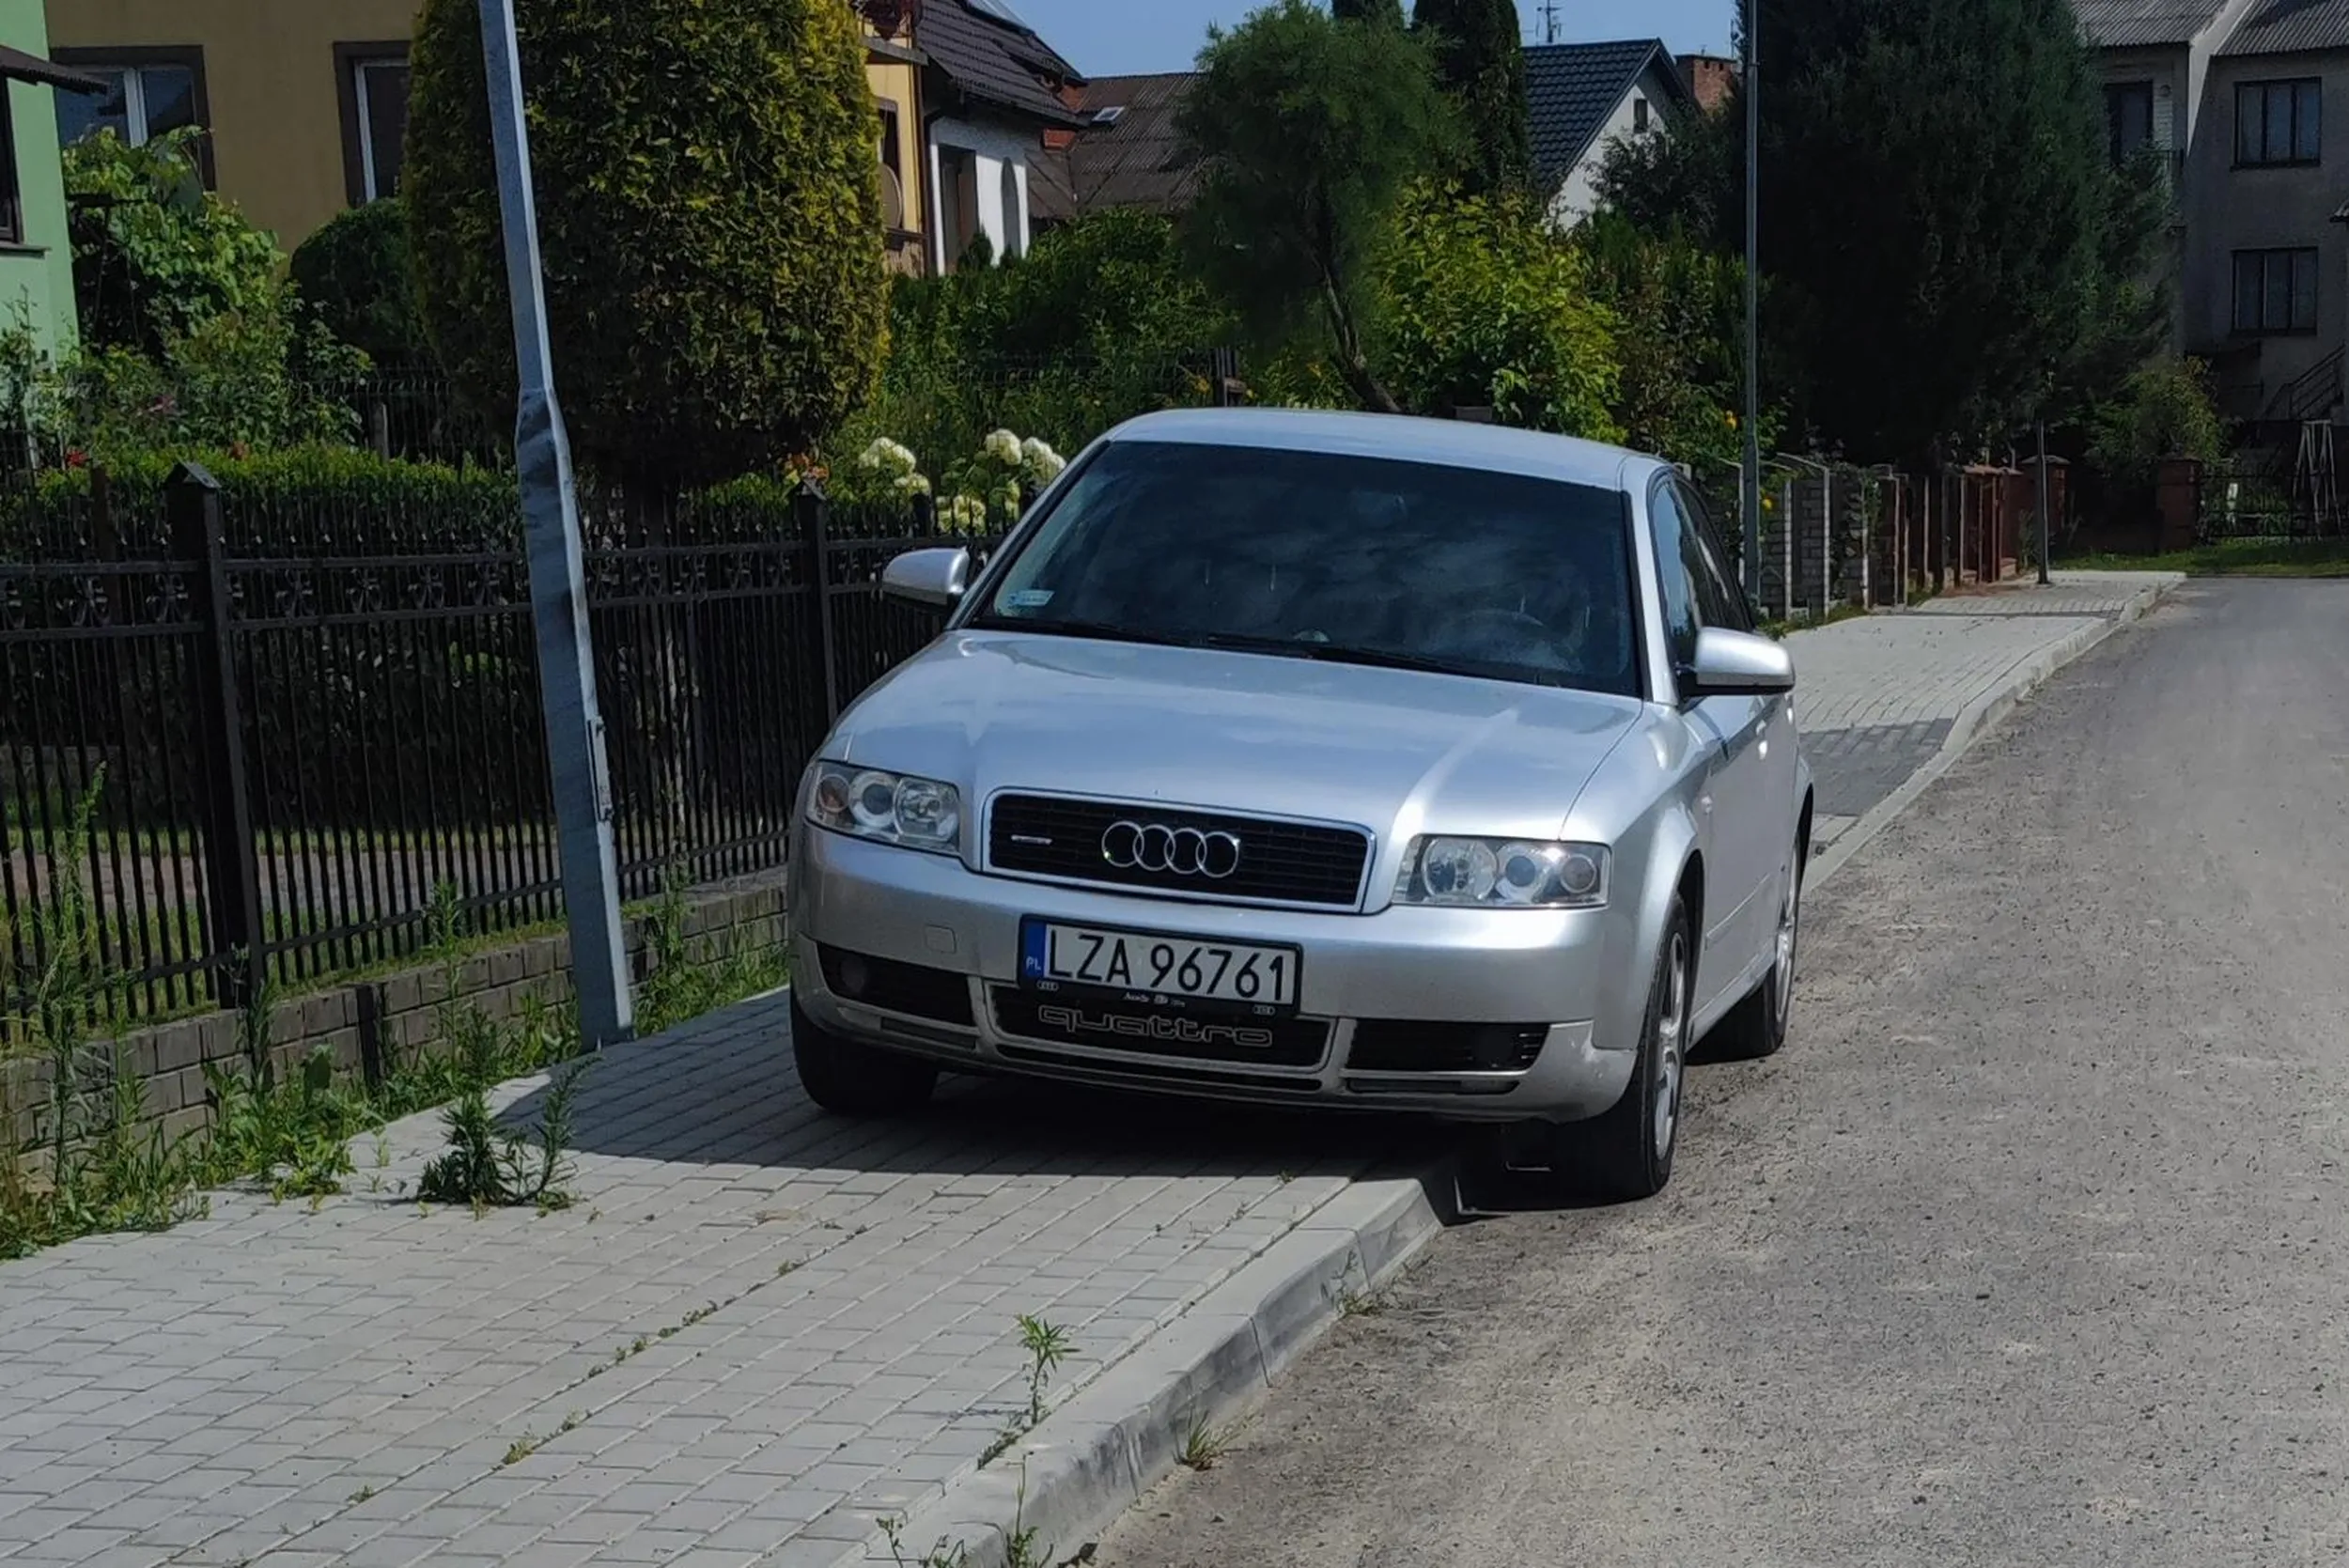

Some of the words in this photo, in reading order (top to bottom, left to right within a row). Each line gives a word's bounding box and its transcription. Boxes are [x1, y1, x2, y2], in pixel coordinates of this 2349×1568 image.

[1025, 955, 1042, 970] PL
[1050, 930, 1131, 985] LZA
[1149, 943, 1283, 1001] 96761
[1038, 1004, 1272, 1048] quattro
